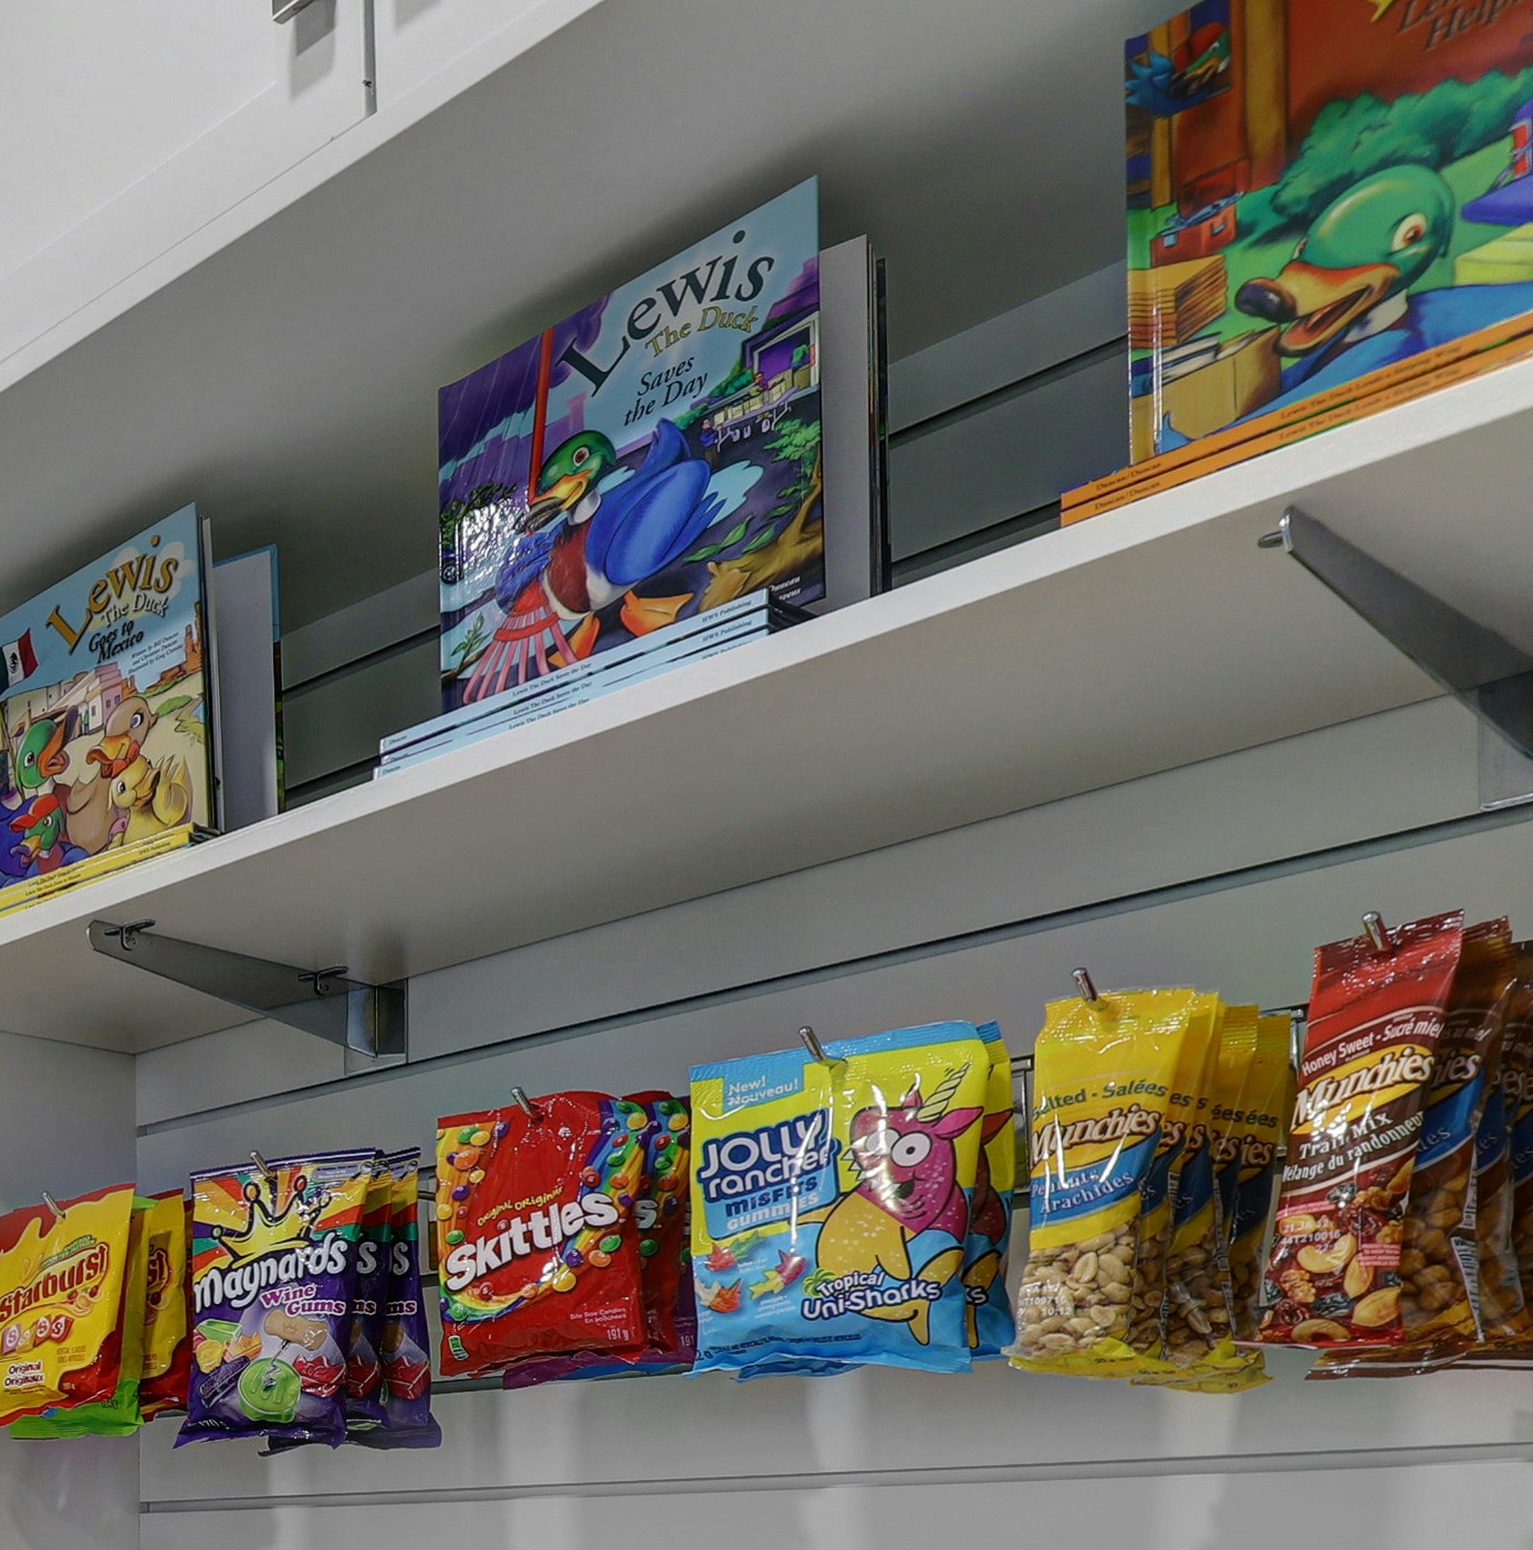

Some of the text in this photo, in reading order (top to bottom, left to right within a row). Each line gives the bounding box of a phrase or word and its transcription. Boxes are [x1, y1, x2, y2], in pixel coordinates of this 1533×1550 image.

[558, 230, 775, 397] Lewis
[644, 305, 758, 361] The Duck
[637, 354, 696, 396] Saves
[623, 370, 709, 427] the Day
[45, 535, 179, 656] Lewis
[101, 592, 170, 628] The Duck
[88, 620, 135, 653] Goes to
[97, 631, 145, 664] Mexico
[1302, 1012, 1444, 1077] Honey Sweet Sucré miel
[728, 1078, 798, 1106] Nouveau!
[729, 1075, 766, 1096] New!
[1102, 1079, 1168, 1099] Salées
[1291, 1048, 1436, 1130] Munchies
[701, 1109, 822, 1179] JOLLY
[1033, 1103, 1161, 1163] Munchies
[1352, 1112, 1393, 1140] Mix
[707, 1145, 828, 1199] rancher
[1283, 1158, 1325, 1182] Mélange
[1328, 1151, 1345, 1169] du
[727, 1193, 819, 1231] GUMMES
[1040, 1172, 1134, 1215] Arachides
[446, 1193, 619, 1291] Skittles
[195, 1232, 348, 1313] Maynards
[818, 1271, 884, 1299] Tropical
[261, 1283, 316, 1307] Wine
[285, 1300, 346, 1317] Gums
[802, 1278, 942, 1321] Uni-Sharks
[607, 1328, 621, 1341] 191
[9, 1361, 42, 1375] Original
